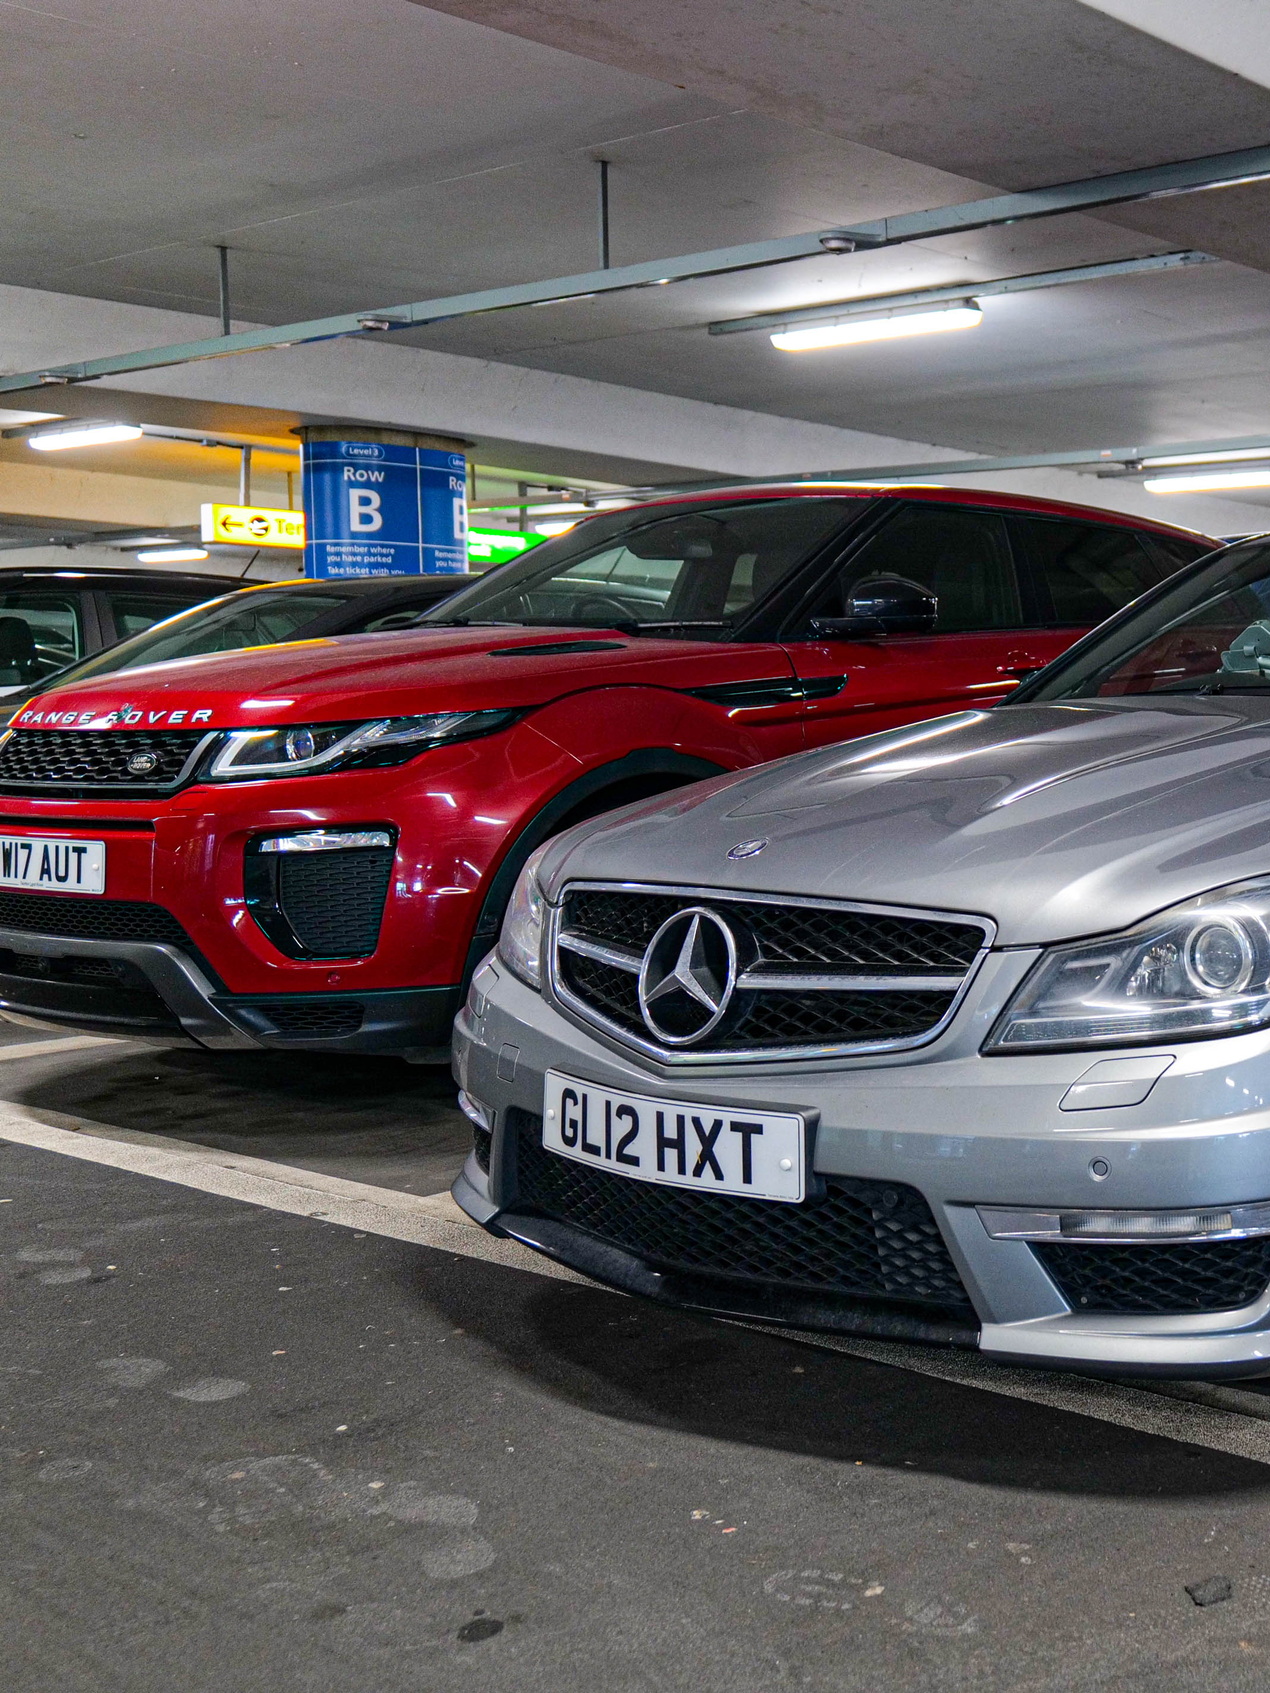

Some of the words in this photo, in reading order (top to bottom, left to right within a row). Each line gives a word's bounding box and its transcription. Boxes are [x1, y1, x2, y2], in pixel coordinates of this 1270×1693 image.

[349, 446, 371, 456] Level
[373, 447, 379, 457] 3
[343, 466, 385, 483] Row
[449, 476, 465, 490] Ro
[349, 488, 383, 533] B
[274, 518, 304, 536] Ter
[326, 544, 368, 554] Remember
[370, 546, 395, 555] where
[435, 550, 464, 560] Remembe
[327, 555, 340, 563] you
[342, 554, 361, 562] have
[363, 556, 392, 564] parked
[327, 566, 344, 575] Take
[346, 566, 370, 575] ticket
[371, 567, 389, 576] with
[19, 710, 96, 725] RANGE
[105, 709, 213, 725] ROVER
[2, 841, 33, 880] W17
[39, 844, 87, 884] AUT
[560, 1087, 640, 1168] GL12
[655, 1110, 763, 1185] HXT
